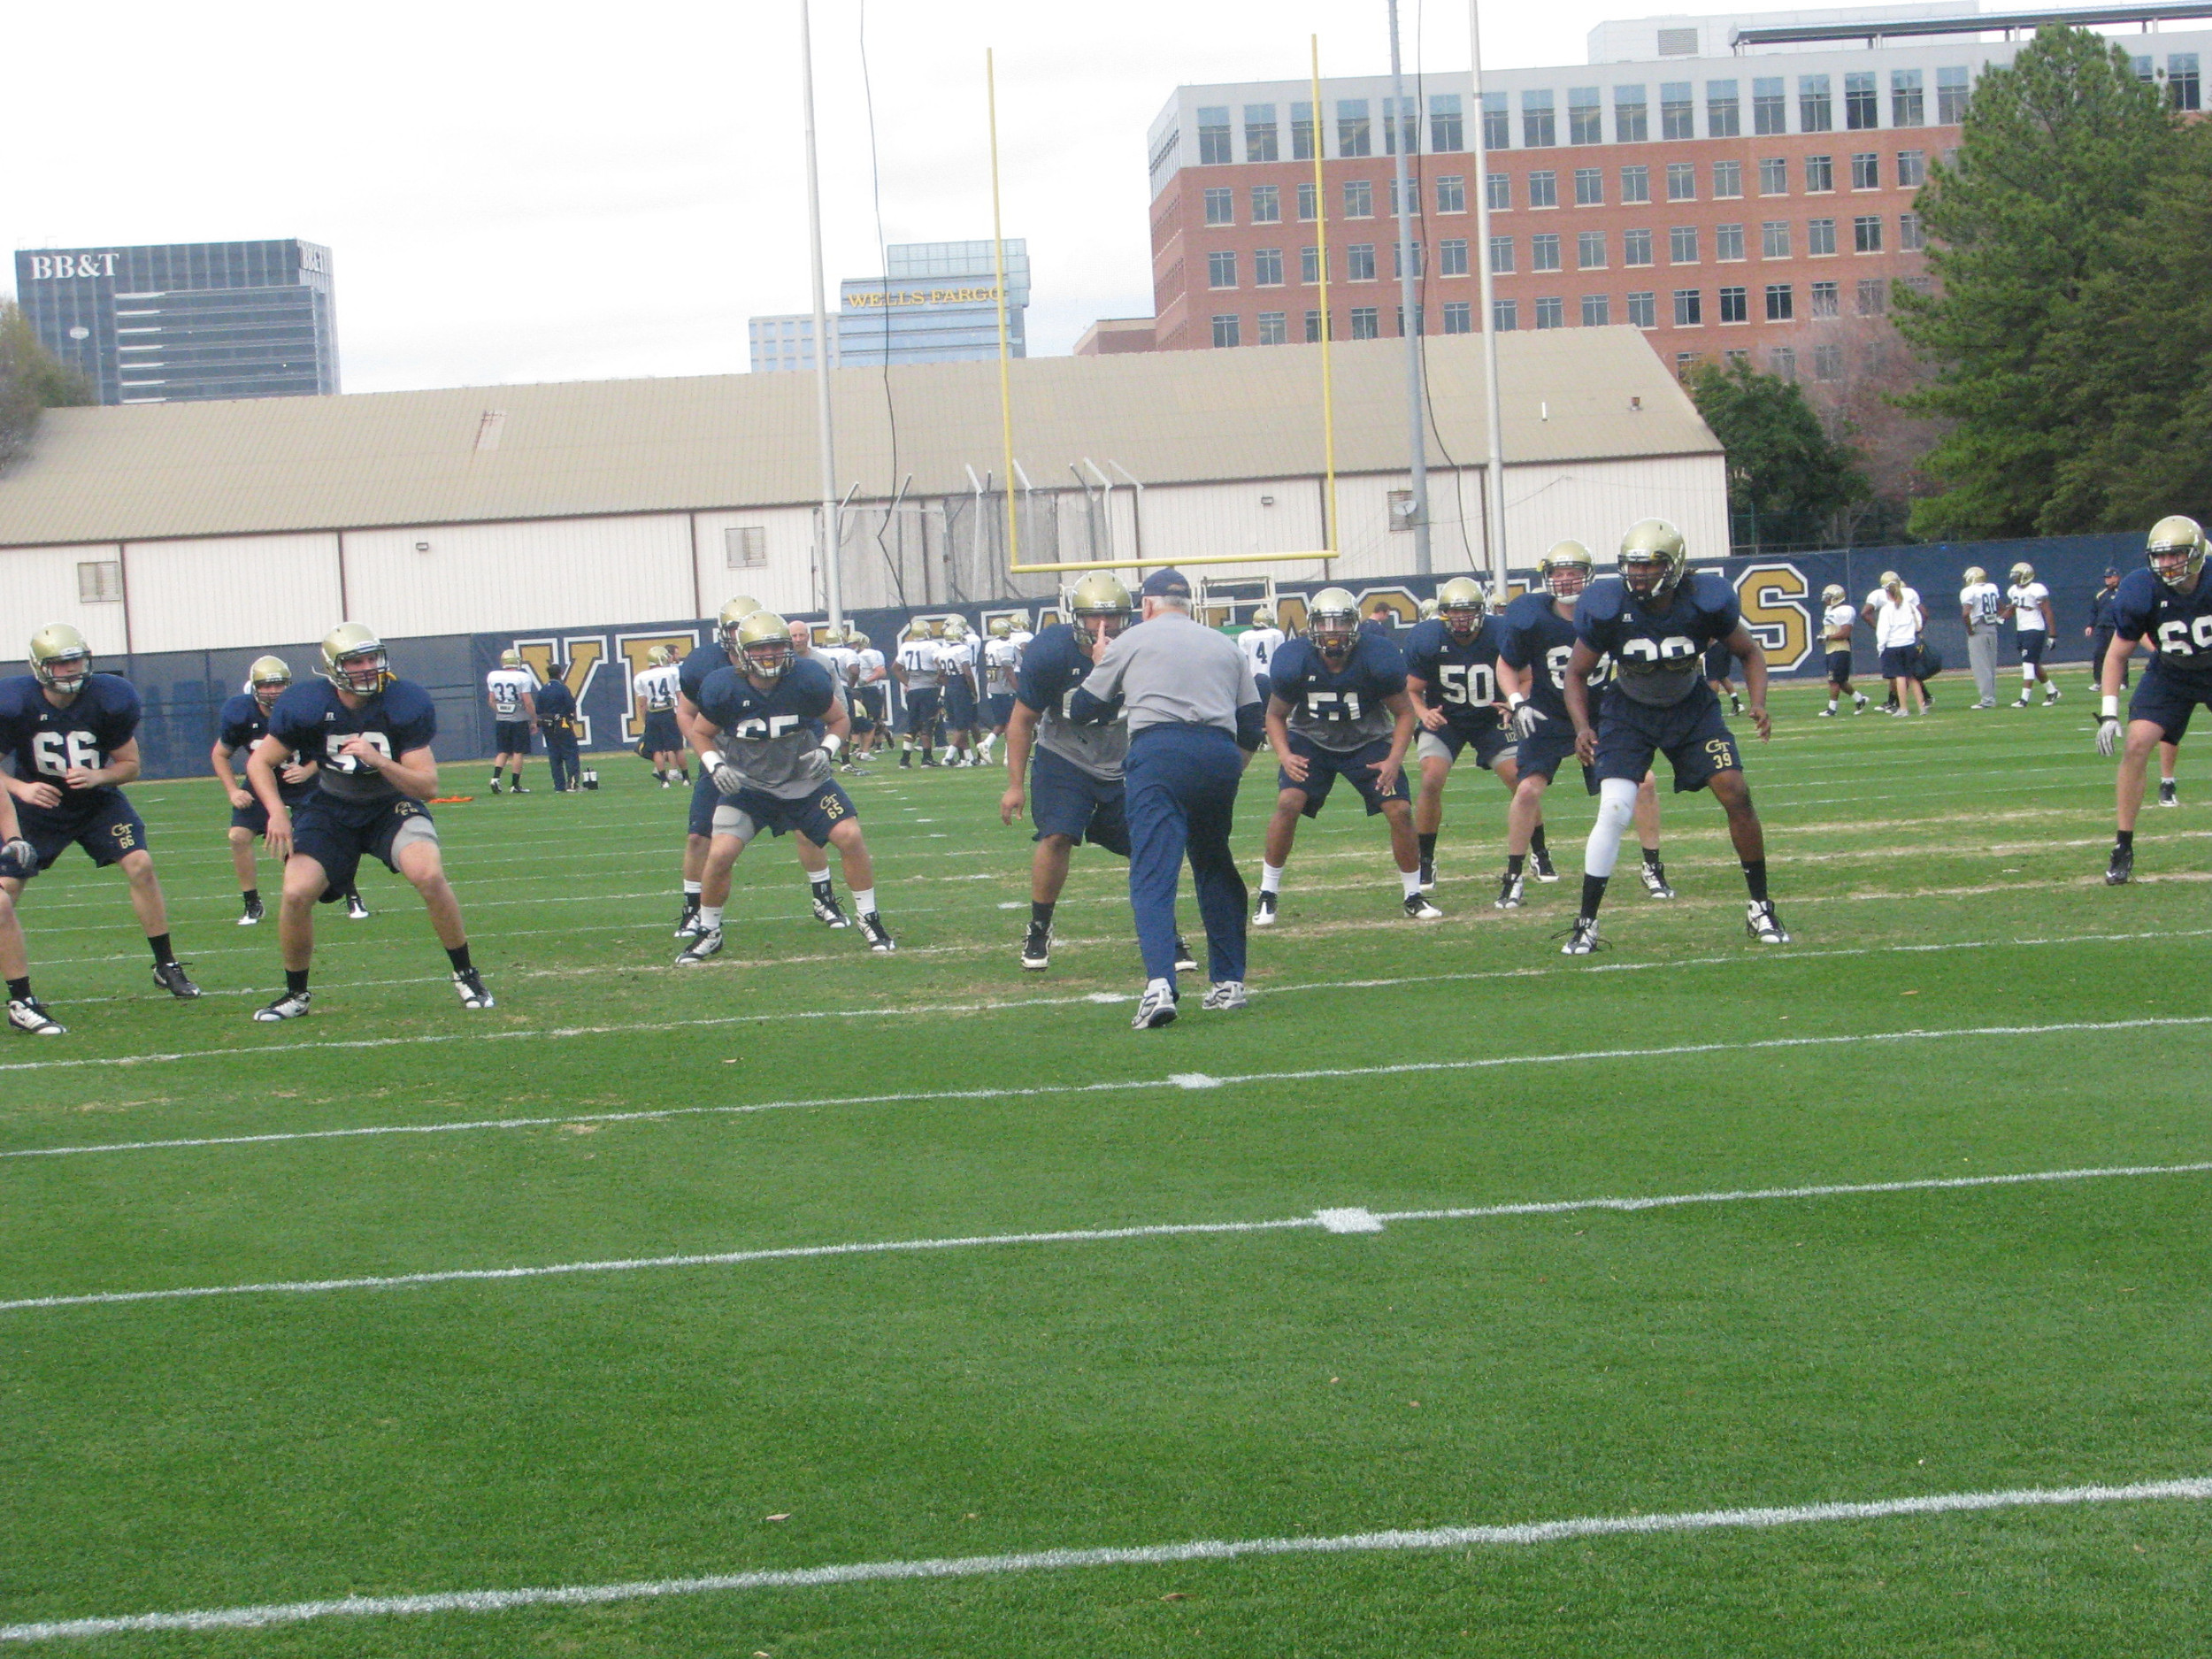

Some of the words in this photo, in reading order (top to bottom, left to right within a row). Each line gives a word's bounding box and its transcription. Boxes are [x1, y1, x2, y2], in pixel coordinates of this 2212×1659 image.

[30, 253, 120, 280] BB&T
[847, 290, 926, 308] WELLS
[1982, 592, 1998, 615] 80
[905, 650, 923, 671] 71
[1256, 641, 1267, 664] 4
[494, 682, 520, 703] 33
[648, 678, 672, 703] 14
[1440, 664, 1494, 707] 50
[33, 731, 100, 778] 66
[1713, 752, 1732, 769] 39
[826, 803, 844, 819] 65
[119, 835, 134, 849] 66
